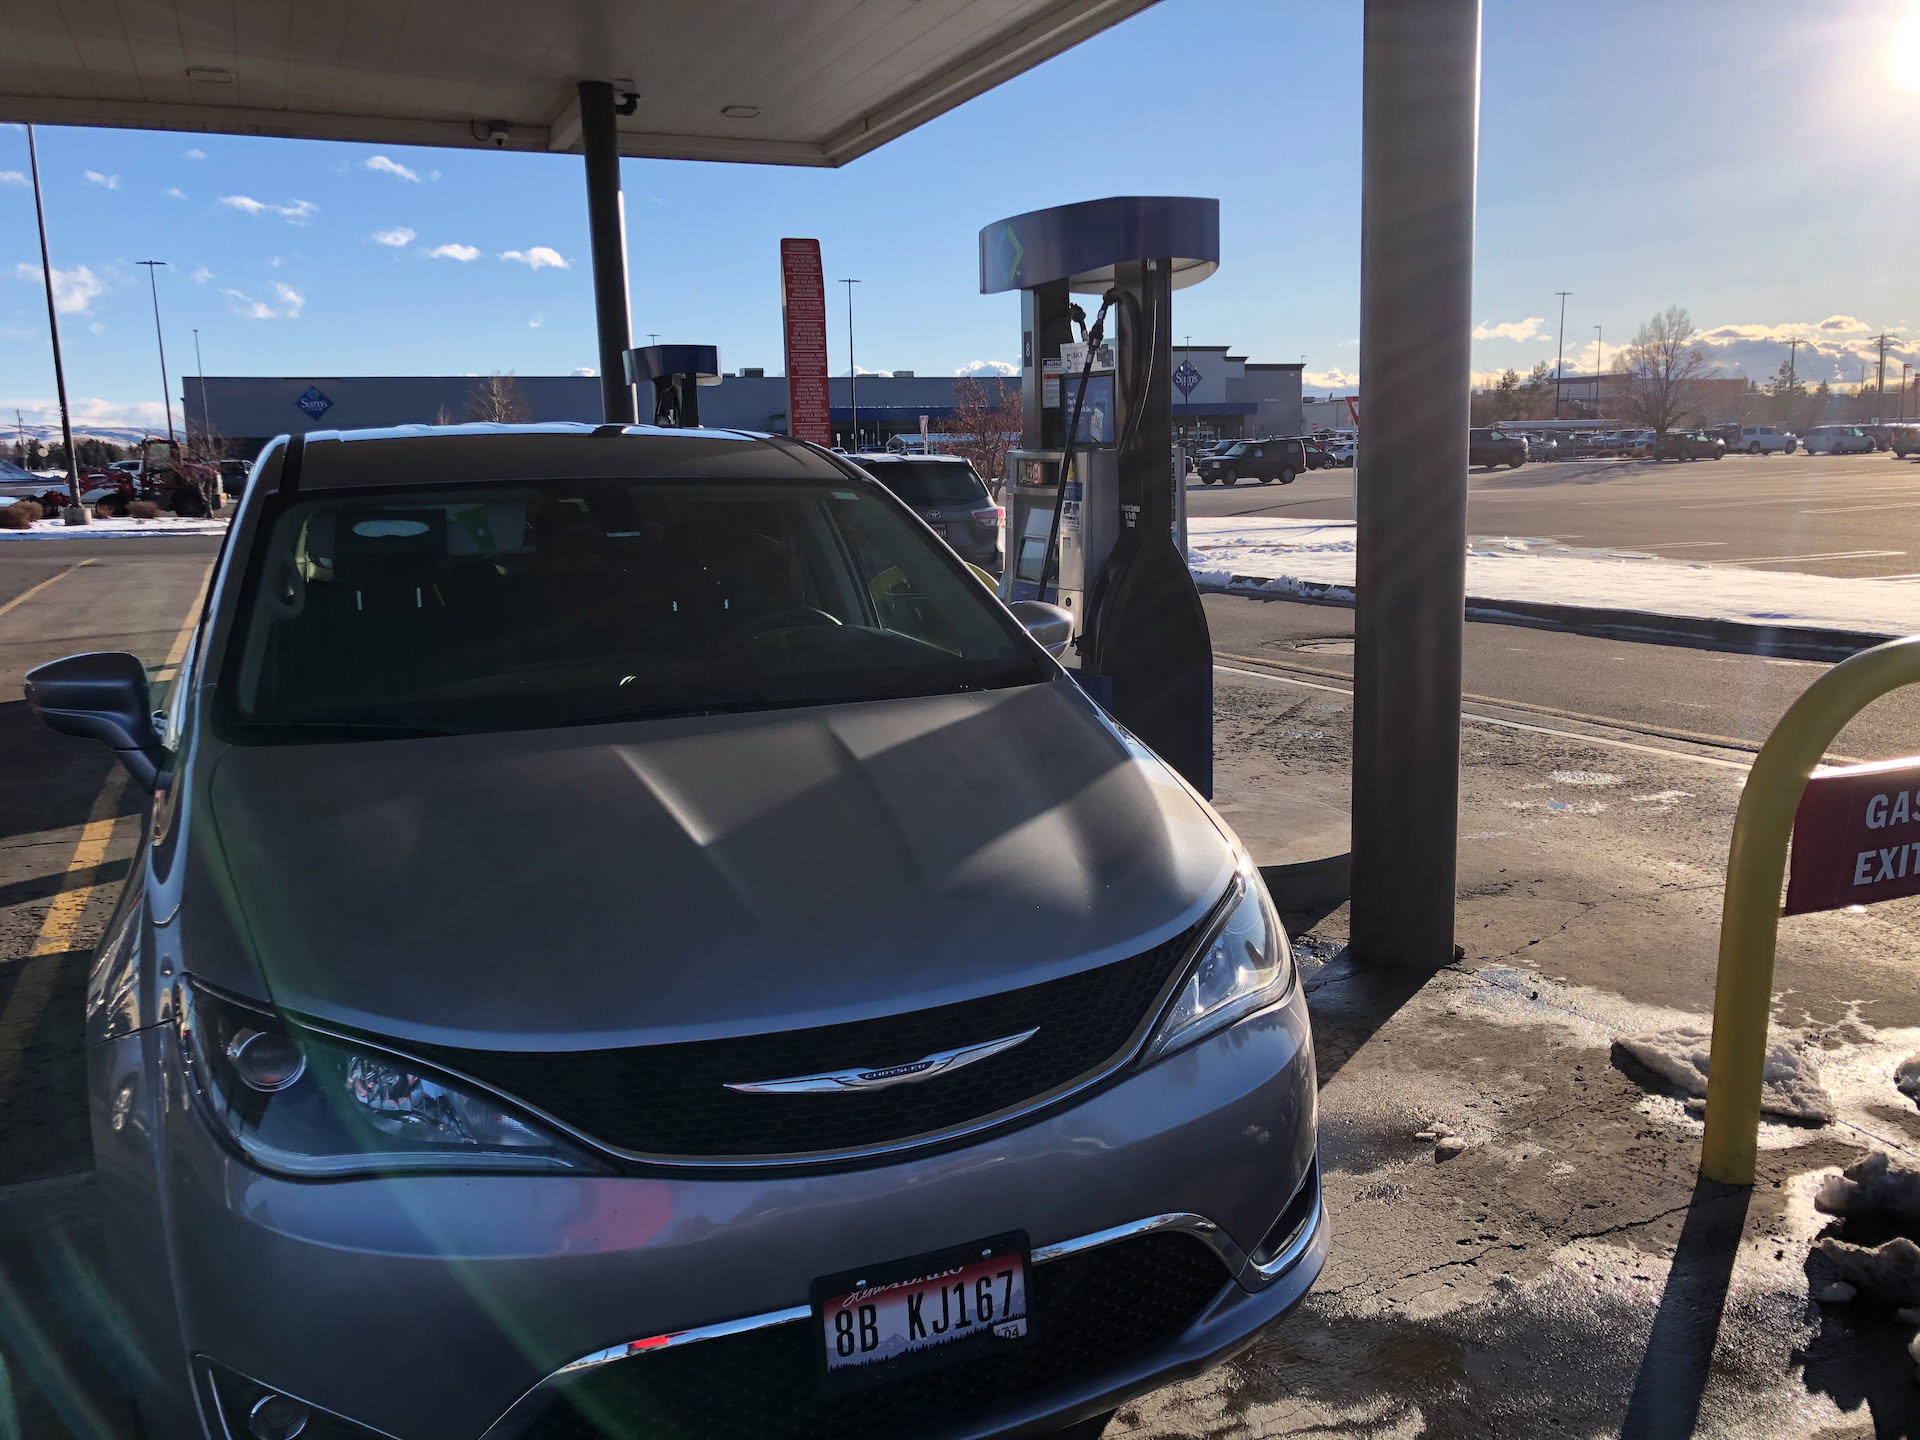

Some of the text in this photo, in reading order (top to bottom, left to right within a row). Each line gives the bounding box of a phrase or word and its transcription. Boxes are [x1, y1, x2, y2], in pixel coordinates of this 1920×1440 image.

[1025, 342, 1031, 358] 8
[864, 1063, 926, 1079] CHRYSLER
[834, 1303, 879, 1358] 8B
[906, 1269, 1014, 1341] KJ167
